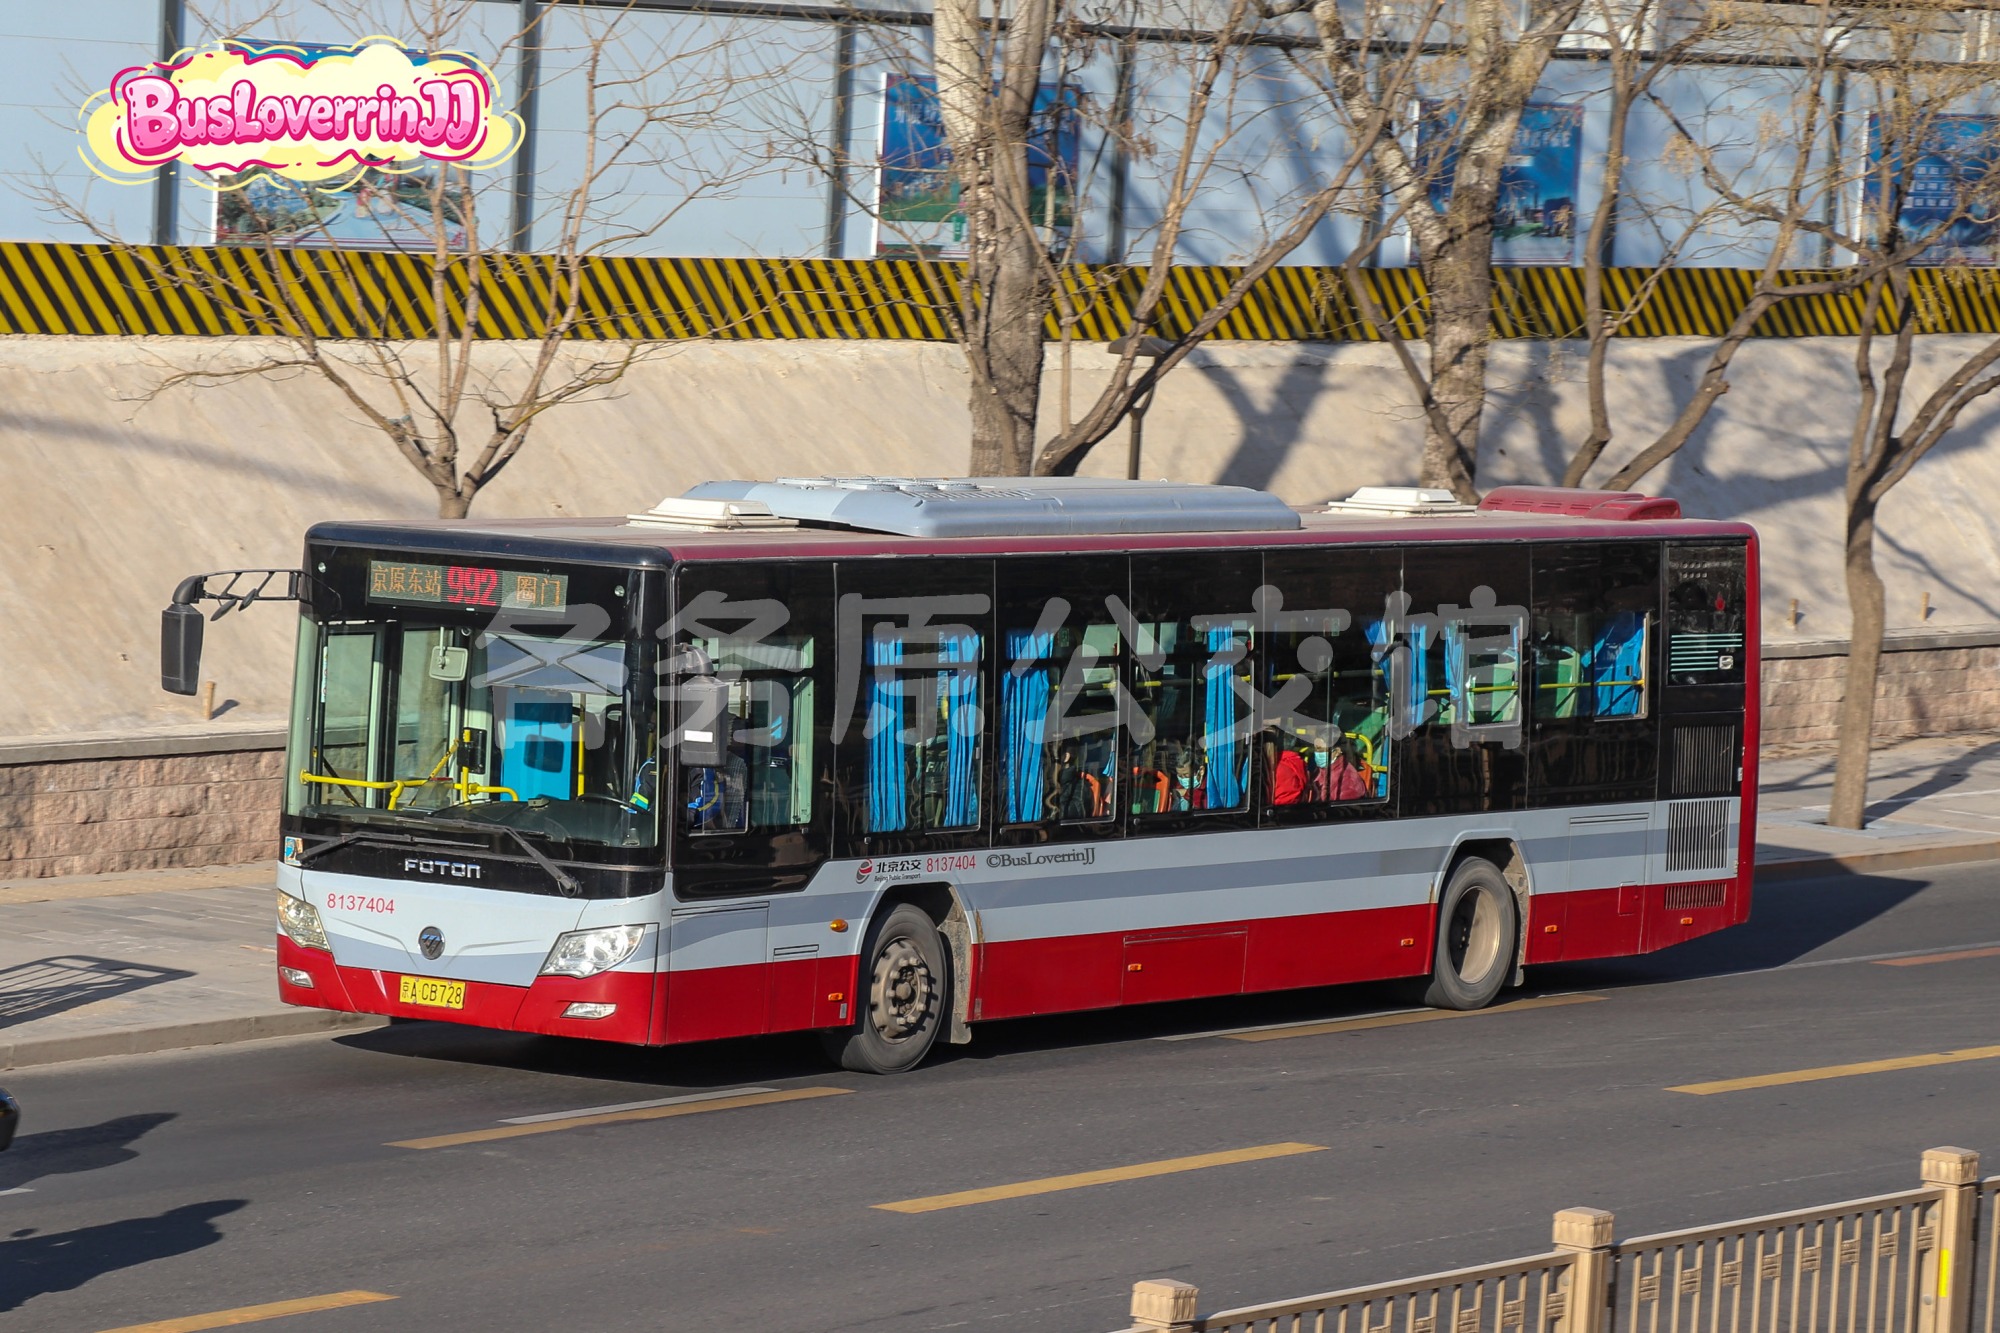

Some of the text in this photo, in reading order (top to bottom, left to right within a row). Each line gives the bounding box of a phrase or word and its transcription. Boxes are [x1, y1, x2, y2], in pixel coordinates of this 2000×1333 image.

[371, 565, 442, 596] 京原东站
[446, 565, 499, 606] 992
[403, 858, 481, 879] FOTON
[875, 859, 922, 873] 北京公交
[926, 855, 976, 873] 8137404
[326, 893, 395, 914] 8137404
